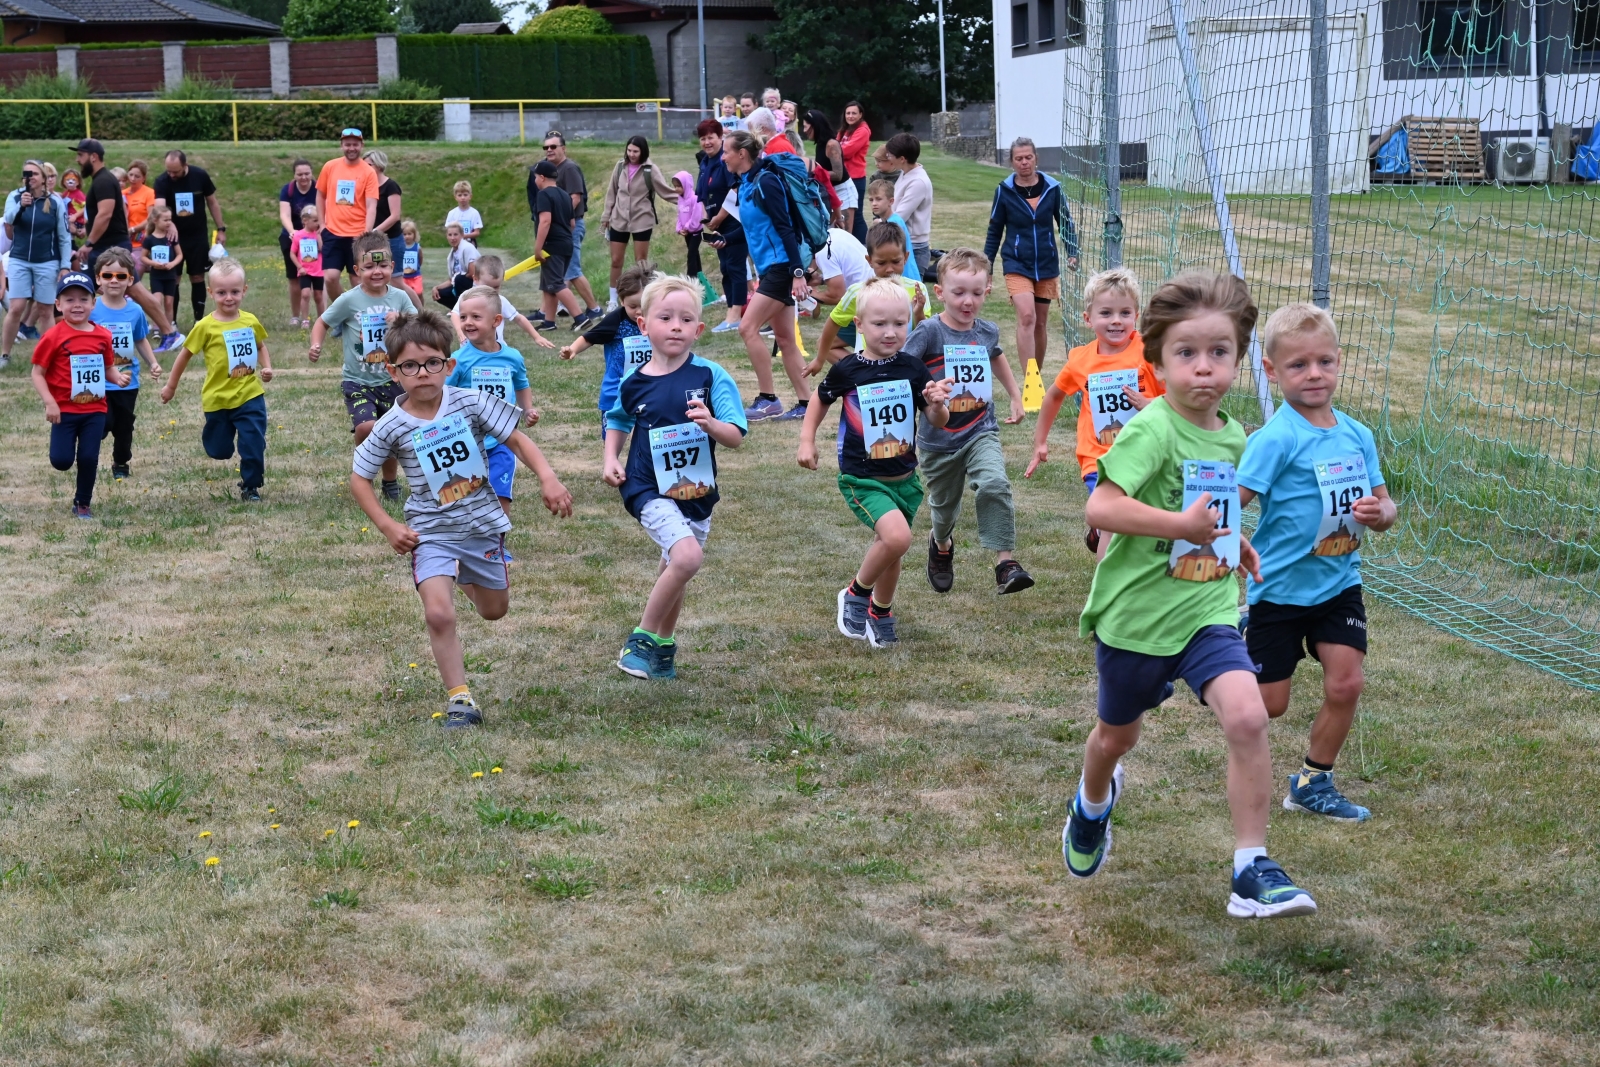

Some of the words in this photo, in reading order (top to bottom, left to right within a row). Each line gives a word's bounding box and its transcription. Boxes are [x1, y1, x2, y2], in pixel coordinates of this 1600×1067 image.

[112, 336, 129, 348] 44
[368, 328, 388, 342] 14
[232, 342, 253, 357] 126
[630, 350, 652, 363] 136
[76, 369, 100, 384] 146
[953, 364, 984, 383] 132
[1097, 392, 1133, 413] 138
[869, 403, 908, 426] 140
[424, 430, 439, 440] CUP
[427, 441, 470, 473] 139
[662, 447, 699, 471] 137
